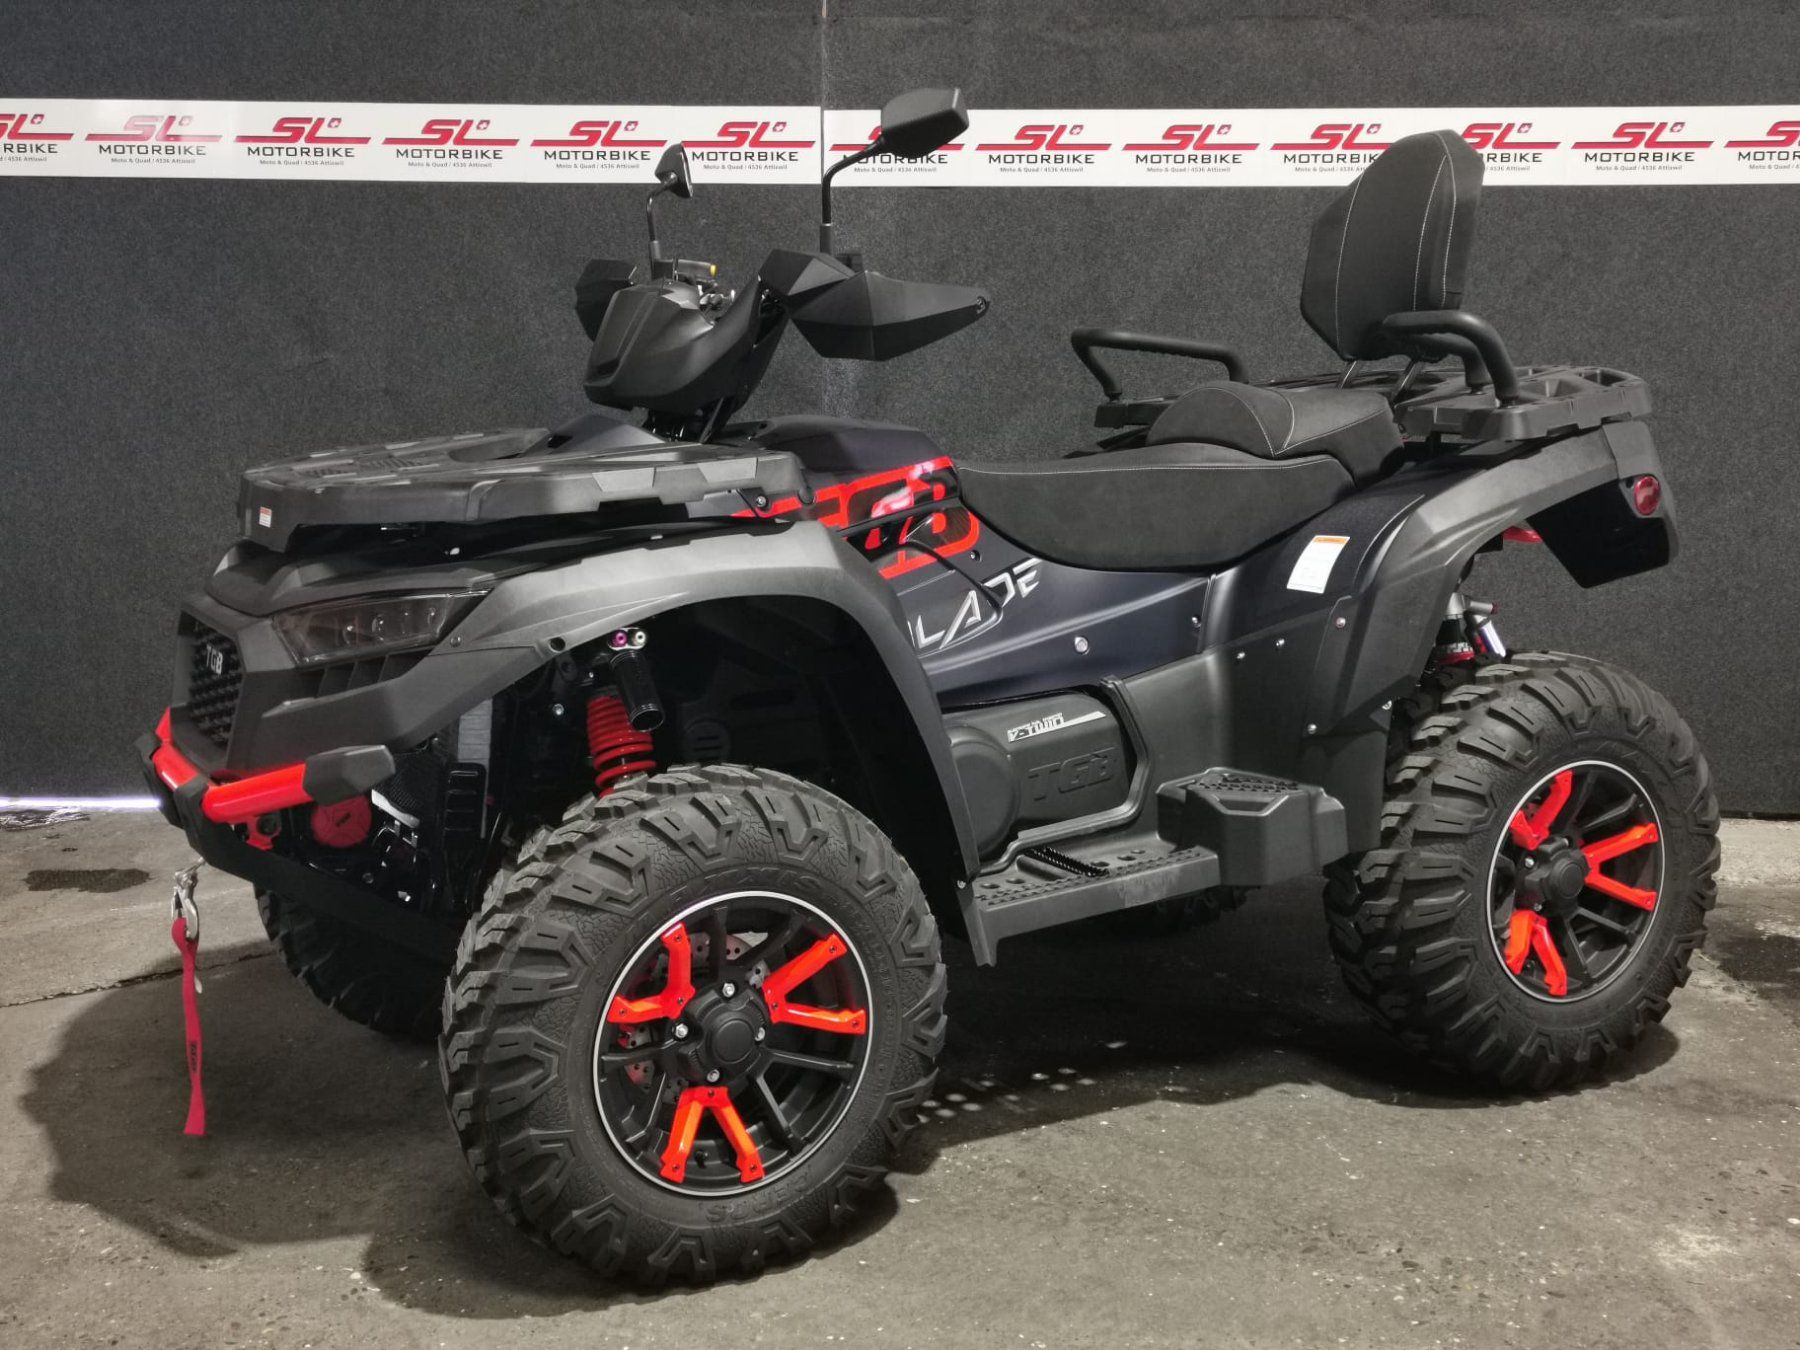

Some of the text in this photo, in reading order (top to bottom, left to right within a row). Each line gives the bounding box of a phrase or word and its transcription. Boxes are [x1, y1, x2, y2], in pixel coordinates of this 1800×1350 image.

[1462, 123, 1560, 151] SL
[4, 144, 58, 154] RBIKE
[99, 145, 206, 156] MOTORBIKE
[248, 146, 354, 157] MOTORBIKE
[397, 149, 503, 159] MOTORBIKE
[545, 150, 650, 161] MOTORBIKE
[693, 151, 798, 162] MOTORBIKE
[989, 154, 1094, 164] MOTORBIKE
[1136, 154, 1241, 164] MOTORBIKE
[1284, 154, 1379, 164] MOTORBIK
[1585, 152, 1694, 162] MOTORBIKE
[908, 557, 1042, 651] LADE
[206, 644, 223, 675] TGB
